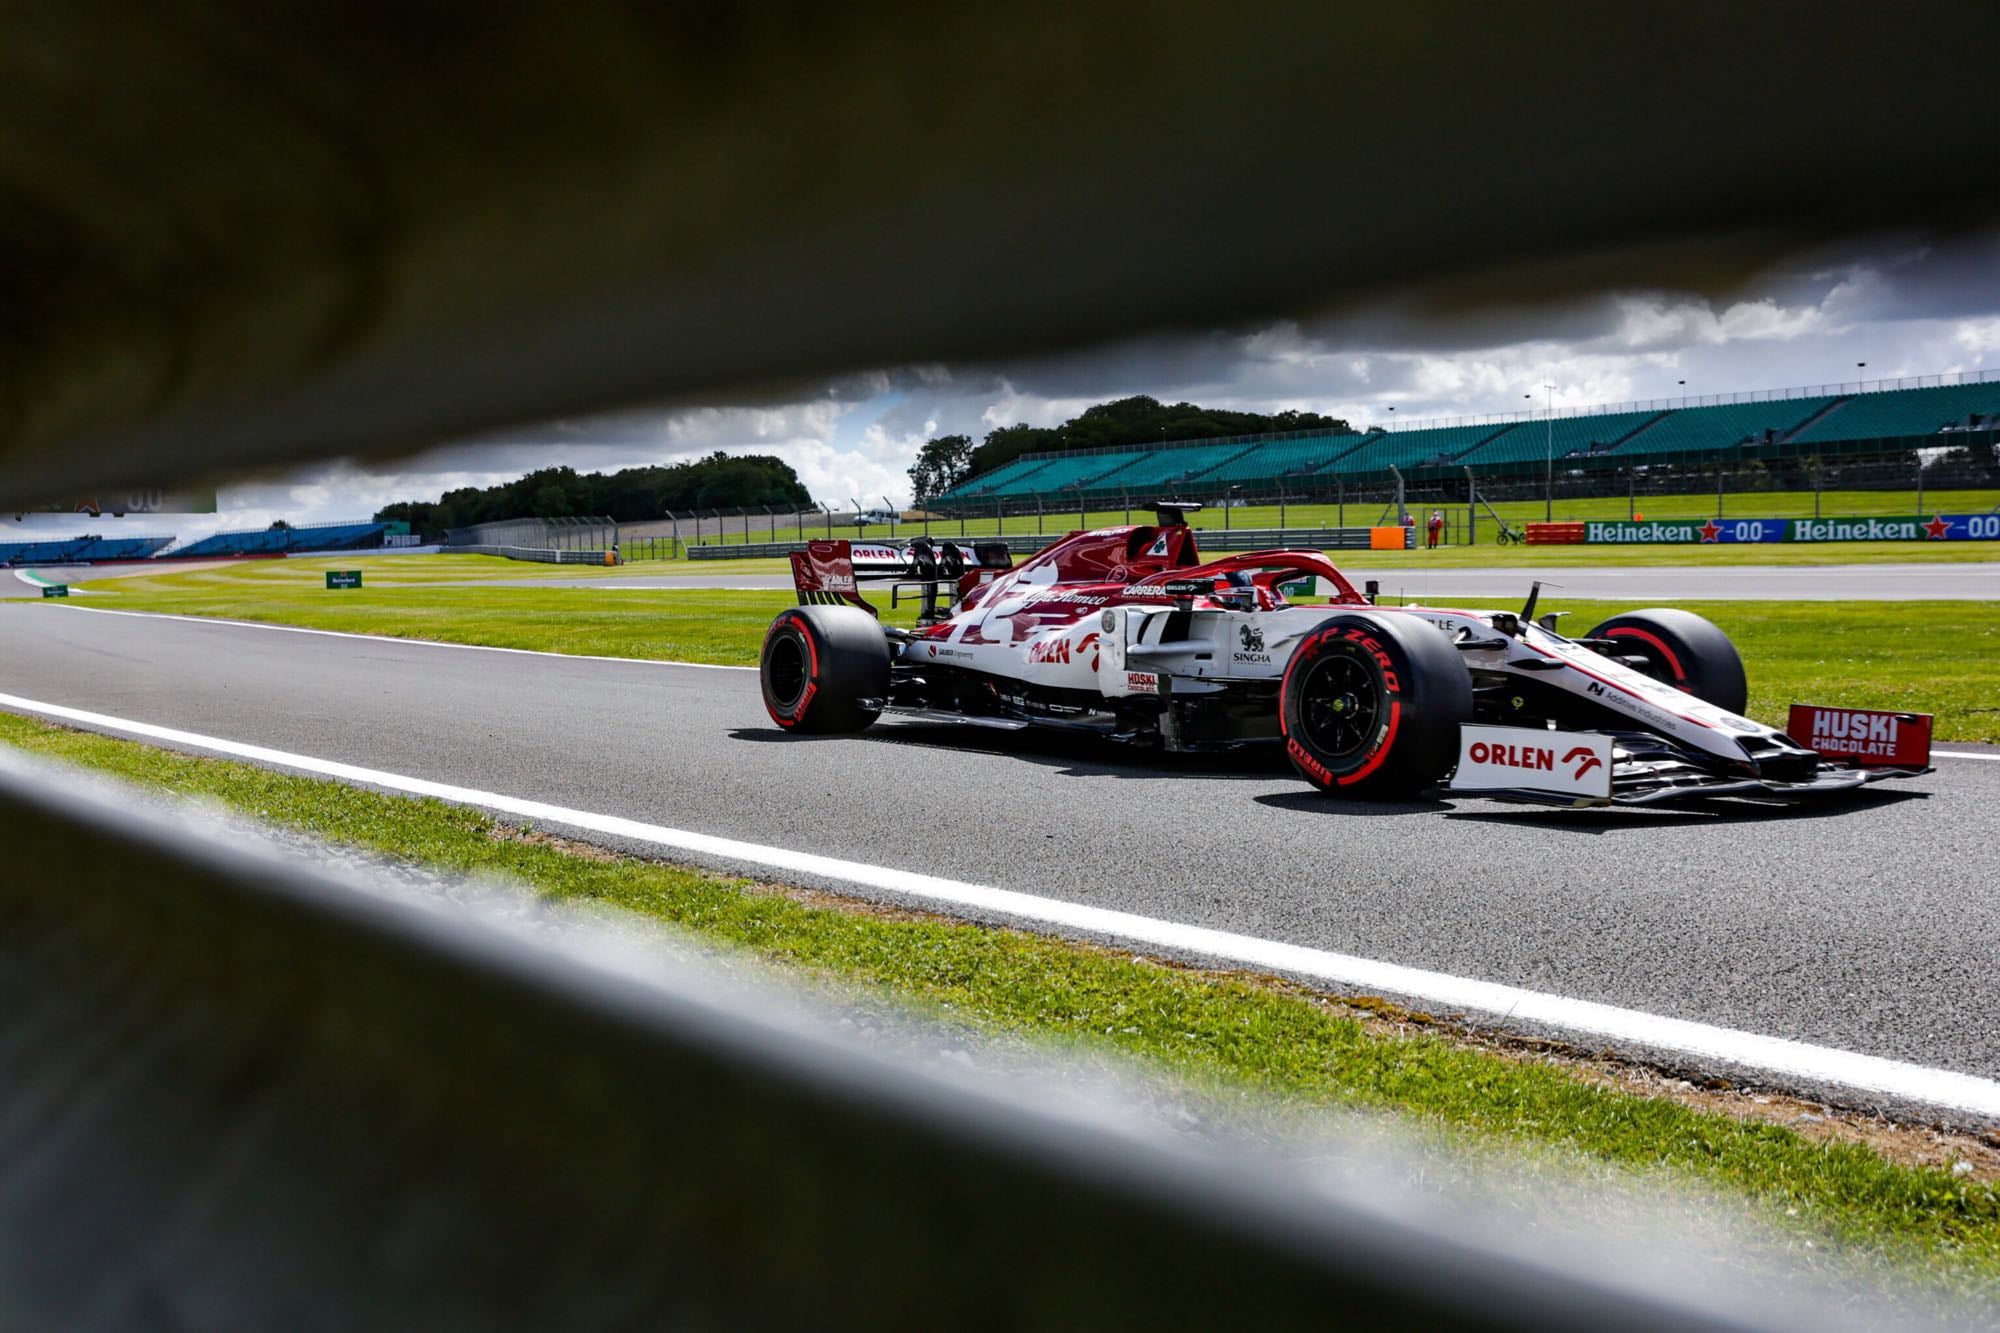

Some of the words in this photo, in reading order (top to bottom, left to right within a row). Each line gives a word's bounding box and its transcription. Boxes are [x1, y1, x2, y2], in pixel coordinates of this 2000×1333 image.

[1588, 523, 1693, 542] Heineken
[1793, 519, 1917, 541] Heineken
[853, 550, 896, 560] ORLEN
[1123, 585, 1166, 596] CARRERA
[1028, 638, 1071, 665] ORLEN
[1233, 652, 1271, 663] SINGHA
[1343, 628, 1400, 693] ZERO
[1813, 710, 1898, 742] HUSKI
[1469, 742, 1554, 771] ORLEN
[1811, 737, 1896, 756] CHOCOLATE
